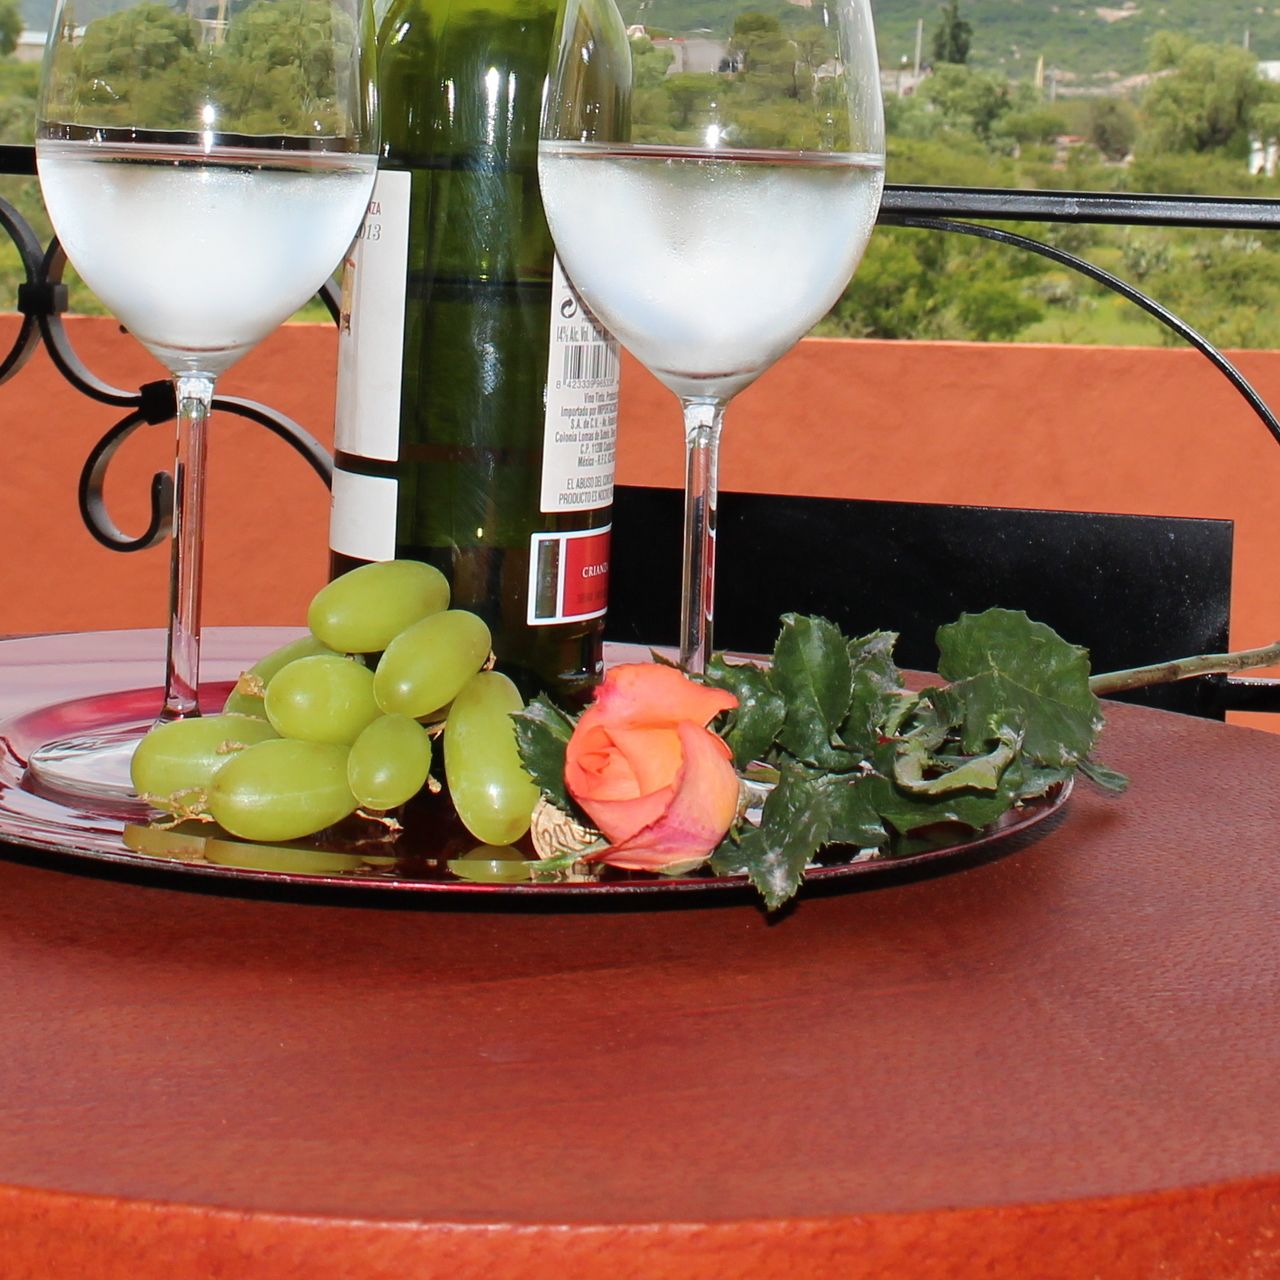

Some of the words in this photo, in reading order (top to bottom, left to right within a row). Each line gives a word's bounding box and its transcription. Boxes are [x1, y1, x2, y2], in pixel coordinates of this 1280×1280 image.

[555, 431, 578, 443] Colonia
[567, 478, 575, 490] EL
[575, 476, 595, 489] ABUSO
[559, 491, 592, 505] PRODUCTO
